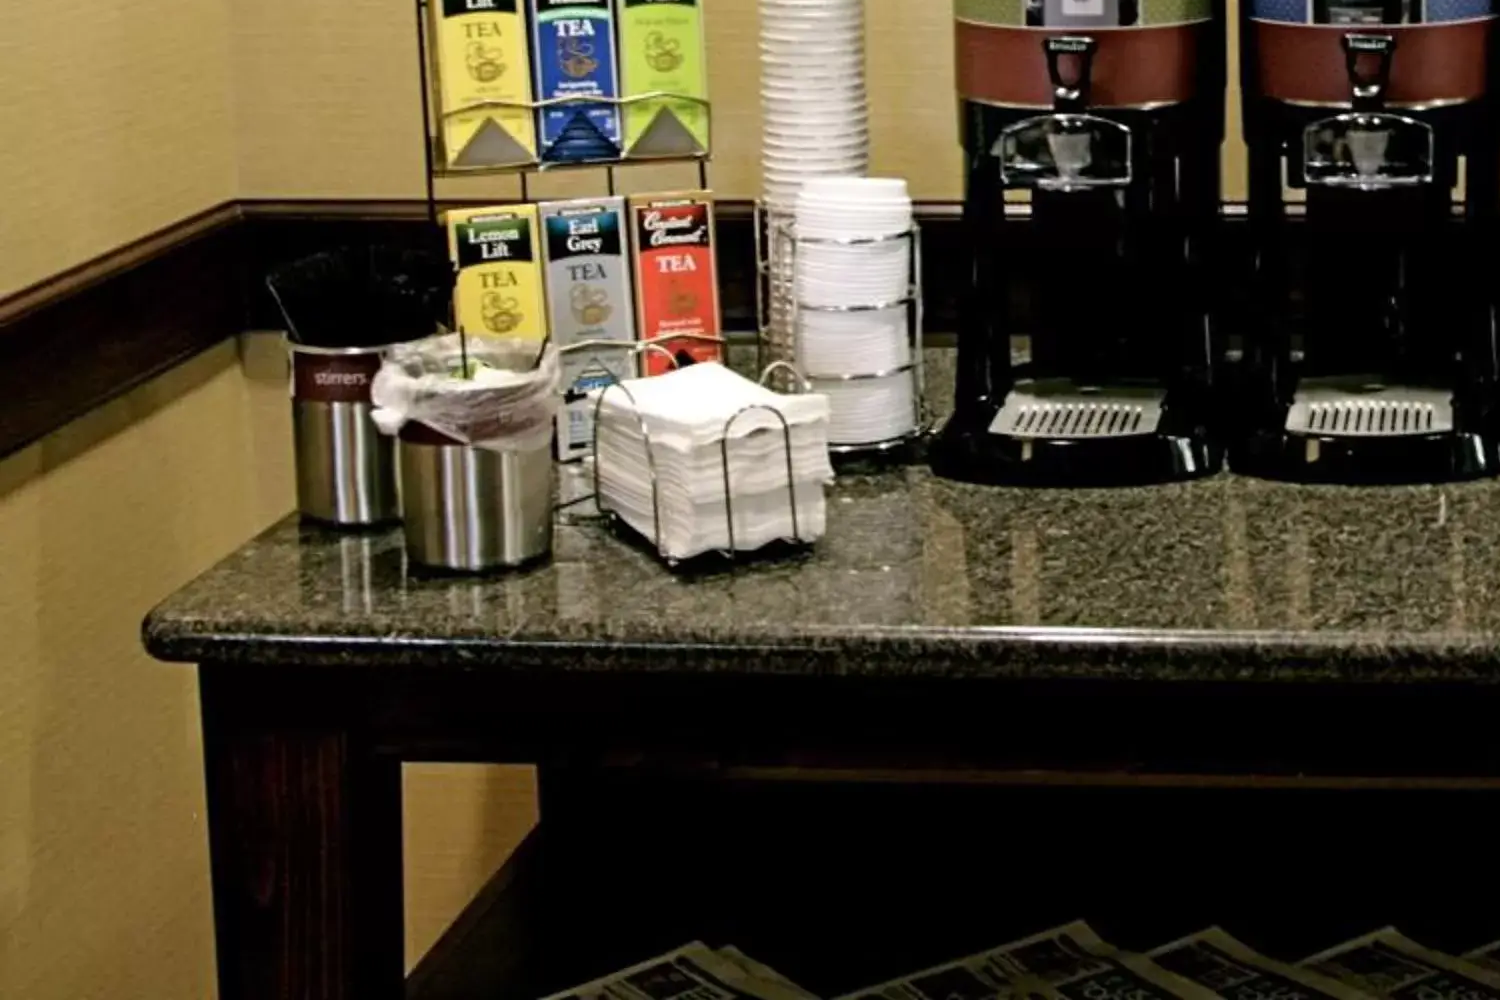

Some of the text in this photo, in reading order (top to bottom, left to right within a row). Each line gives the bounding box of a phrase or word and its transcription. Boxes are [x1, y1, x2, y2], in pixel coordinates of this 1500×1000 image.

[461, 21, 503, 39] TEA
[552, 18, 596, 37] TEA
[568, 217, 600, 235] Earl
[468, 228, 519, 244] Lemon
[566, 235, 604, 254] Grey
[480, 242, 512, 259] Lift
[566, 262, 608, 282] TEA
[655, 252, 697, 274] TEA
[477, 271, 519, 289] TEA
[313, 369, 368, 386] stirrers
